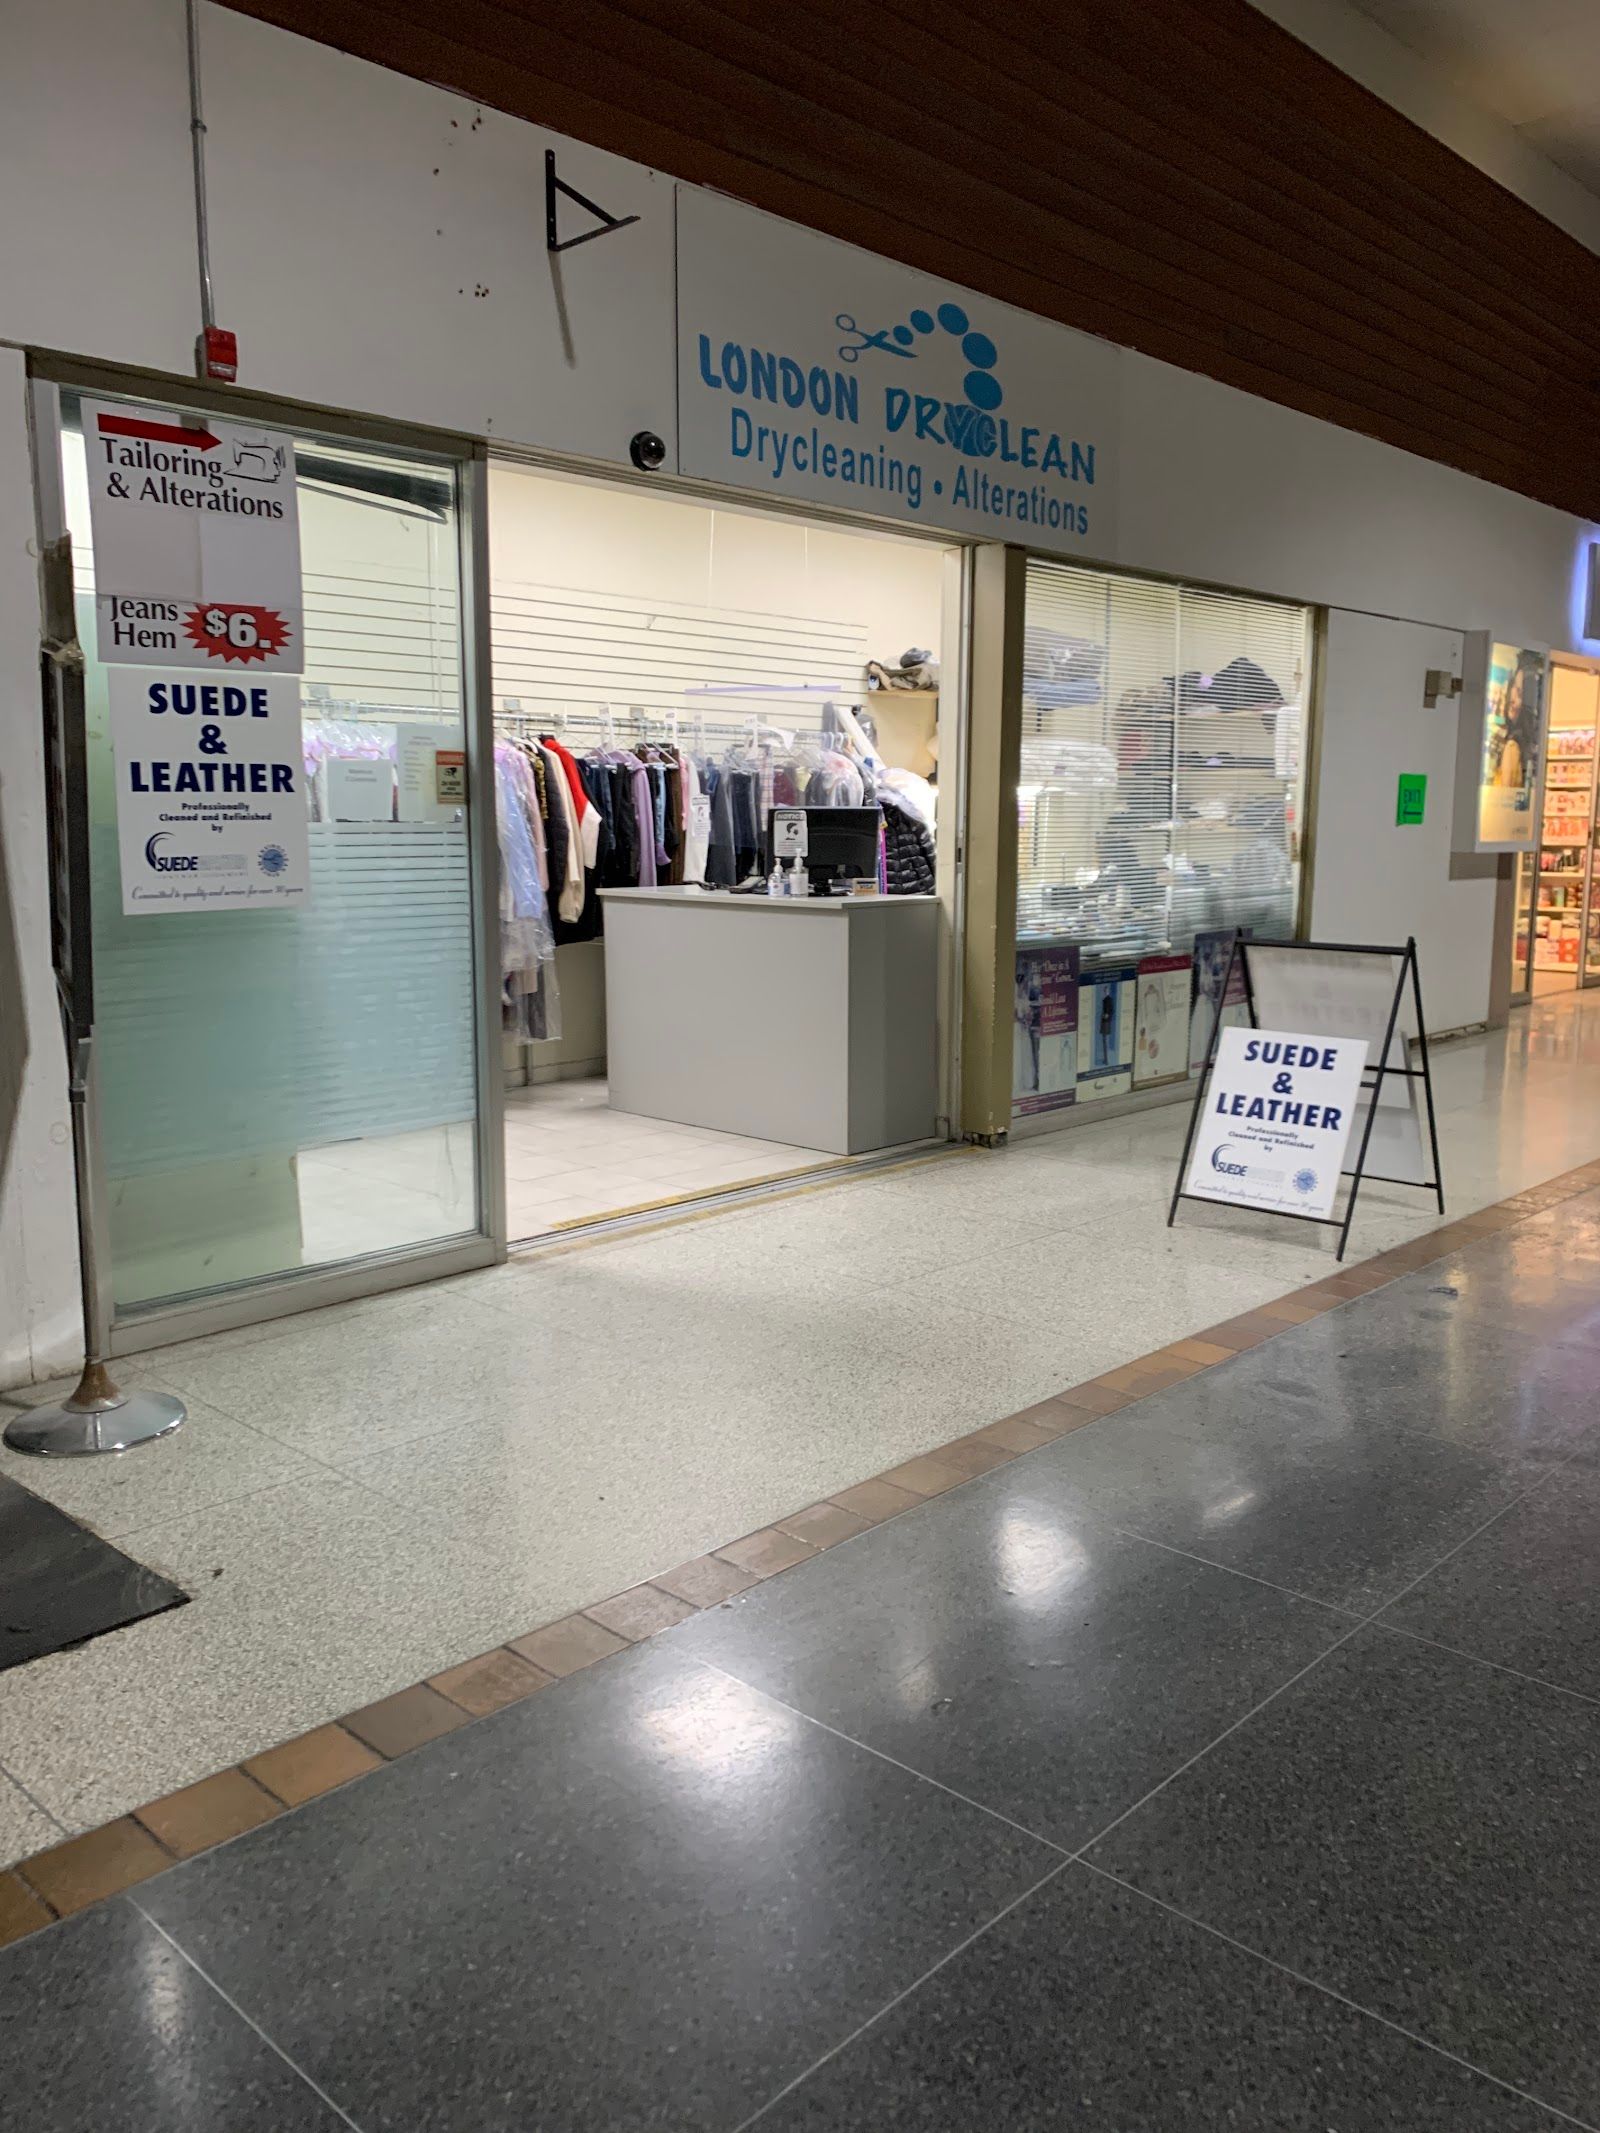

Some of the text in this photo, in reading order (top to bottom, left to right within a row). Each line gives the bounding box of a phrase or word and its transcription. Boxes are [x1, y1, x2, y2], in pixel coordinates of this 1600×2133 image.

[699, 334, 1096, 485] LONDON DRYCLEAN
[99, 437, 224, 488] Tailoring
[731, 407, 1089, 535] Drycleaning Alterations
[107, 472, 284, 519] & Alterations
[110, 595, 179, 622] Jeans
[113, 622, 177, 649] Hem
[148, 683, 269, 718] SUEDE
[198, 724, 229, 755] &
[130, 761, 296, 793] LEATHER
[159, 812, 273, 821] Cleaned and Refinished
[181, 802, 250, 812] Professionally
[211, 823, 224, 833] by
[156, 855, 199, 873] SUEDE
[1244, 1039, 1338, 1071] SUEDE
[1272, 1071, 1293, 1095] &
[1215, 1092, 1343, 1131] LEATHER
[1216, 1161, 1248, 1177] SUEDE
